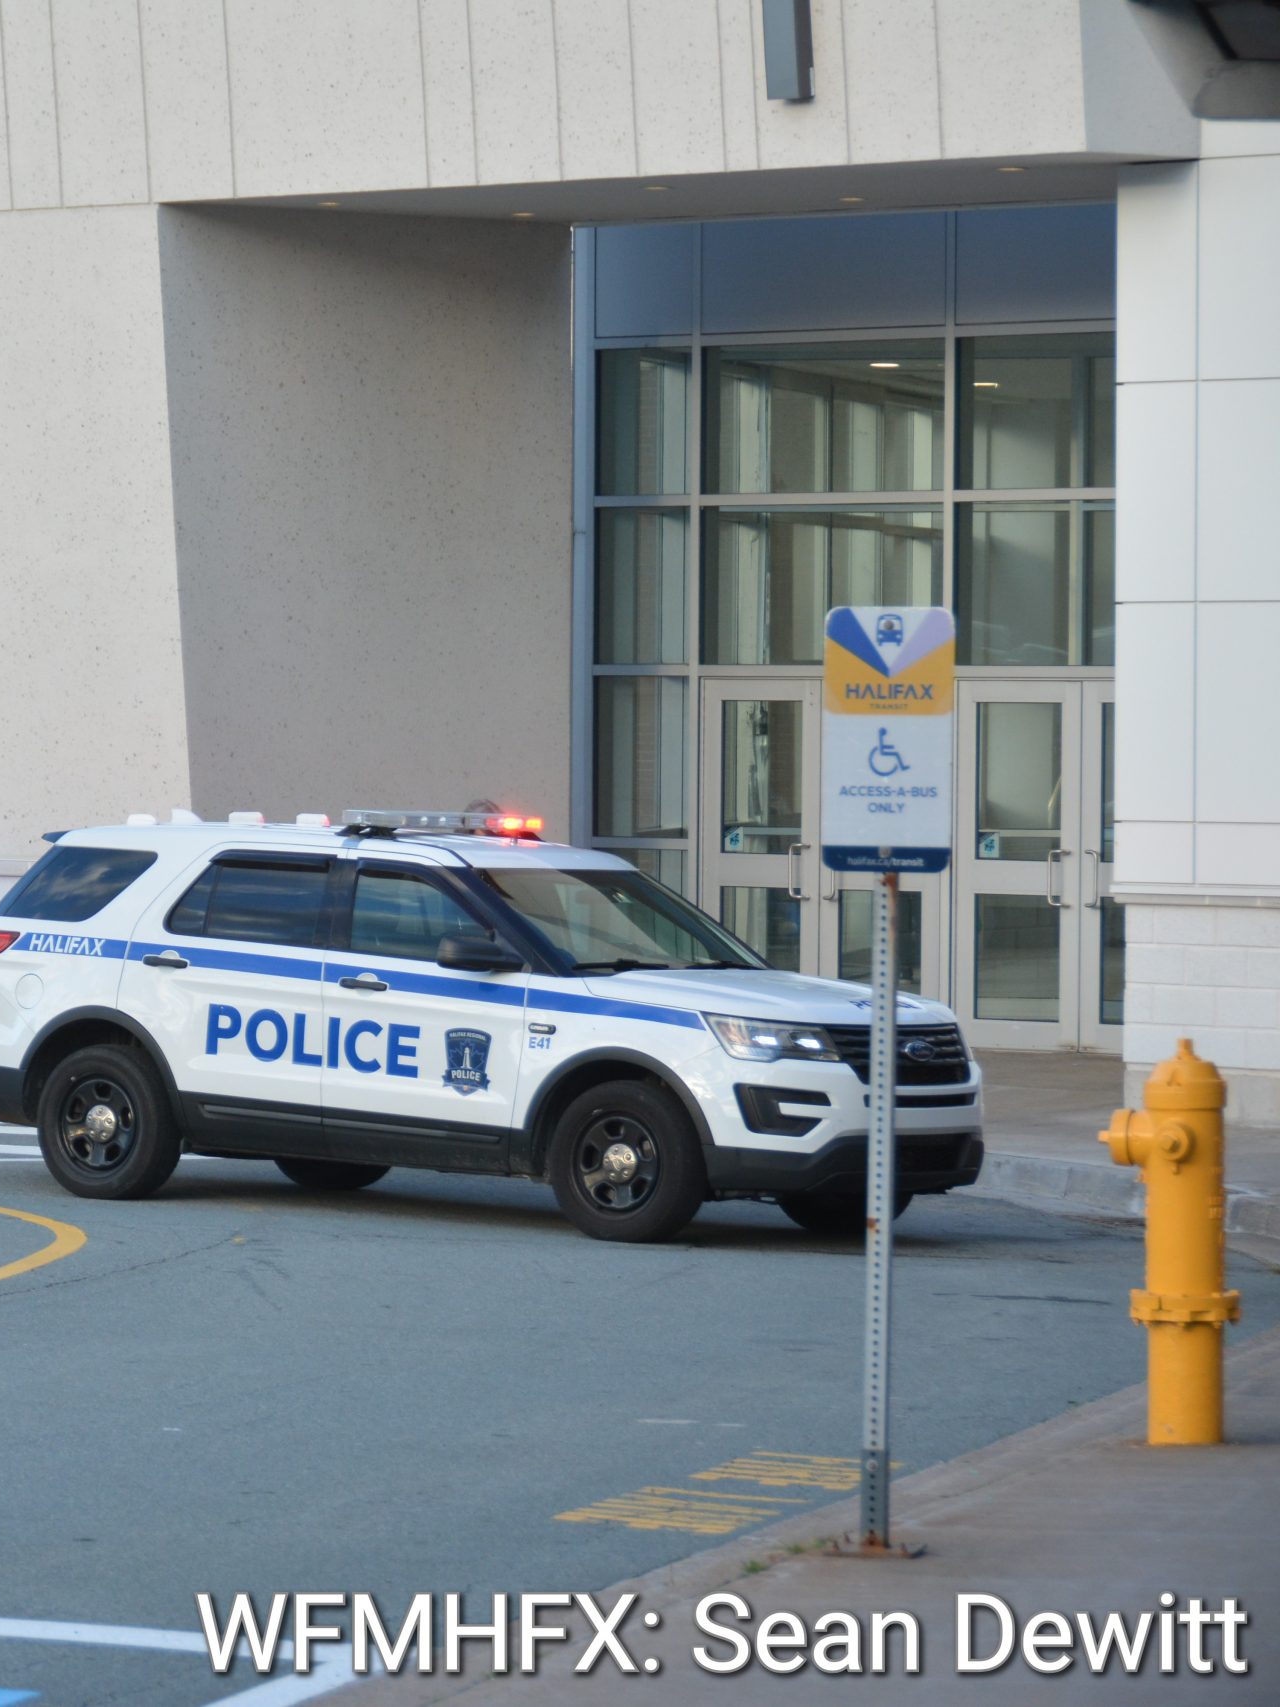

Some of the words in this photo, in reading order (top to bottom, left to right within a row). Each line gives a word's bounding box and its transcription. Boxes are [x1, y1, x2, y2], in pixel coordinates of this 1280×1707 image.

[845, 683, 933, 700] HALIFAX
[839, 785, 937, 798] ACCESS-A-BUS
[867, 802, 905, 813] ONLY
[847, 856, 925, 867] halifax.ca/transit
[29, 934, 105, 956] HALIFAX
[205, 1003, 421, 1079] POLICE
[528, 1037, 551, 1049] E41
[451, 1070, 481, 1081] POLICE
